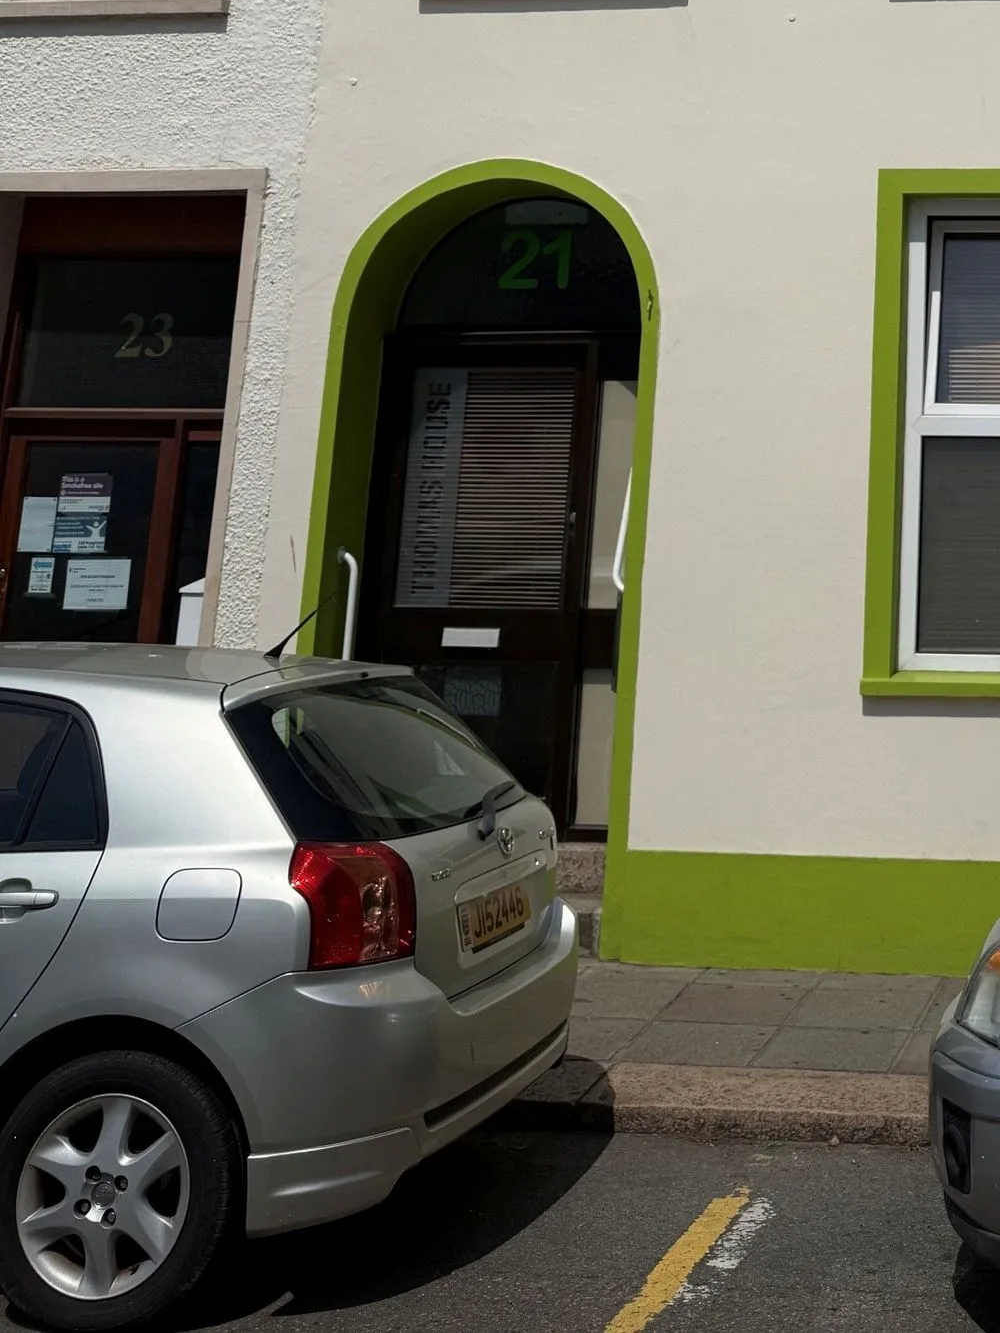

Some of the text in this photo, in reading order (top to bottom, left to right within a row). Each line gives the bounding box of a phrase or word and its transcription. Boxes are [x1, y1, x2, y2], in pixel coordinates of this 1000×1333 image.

[498, 230, 572, 289] 21
[114, 312, 174, 358] 23
[410, 381, 452, 594] THOMAS HOUSE
[474, 887, 523, 938] J152446
